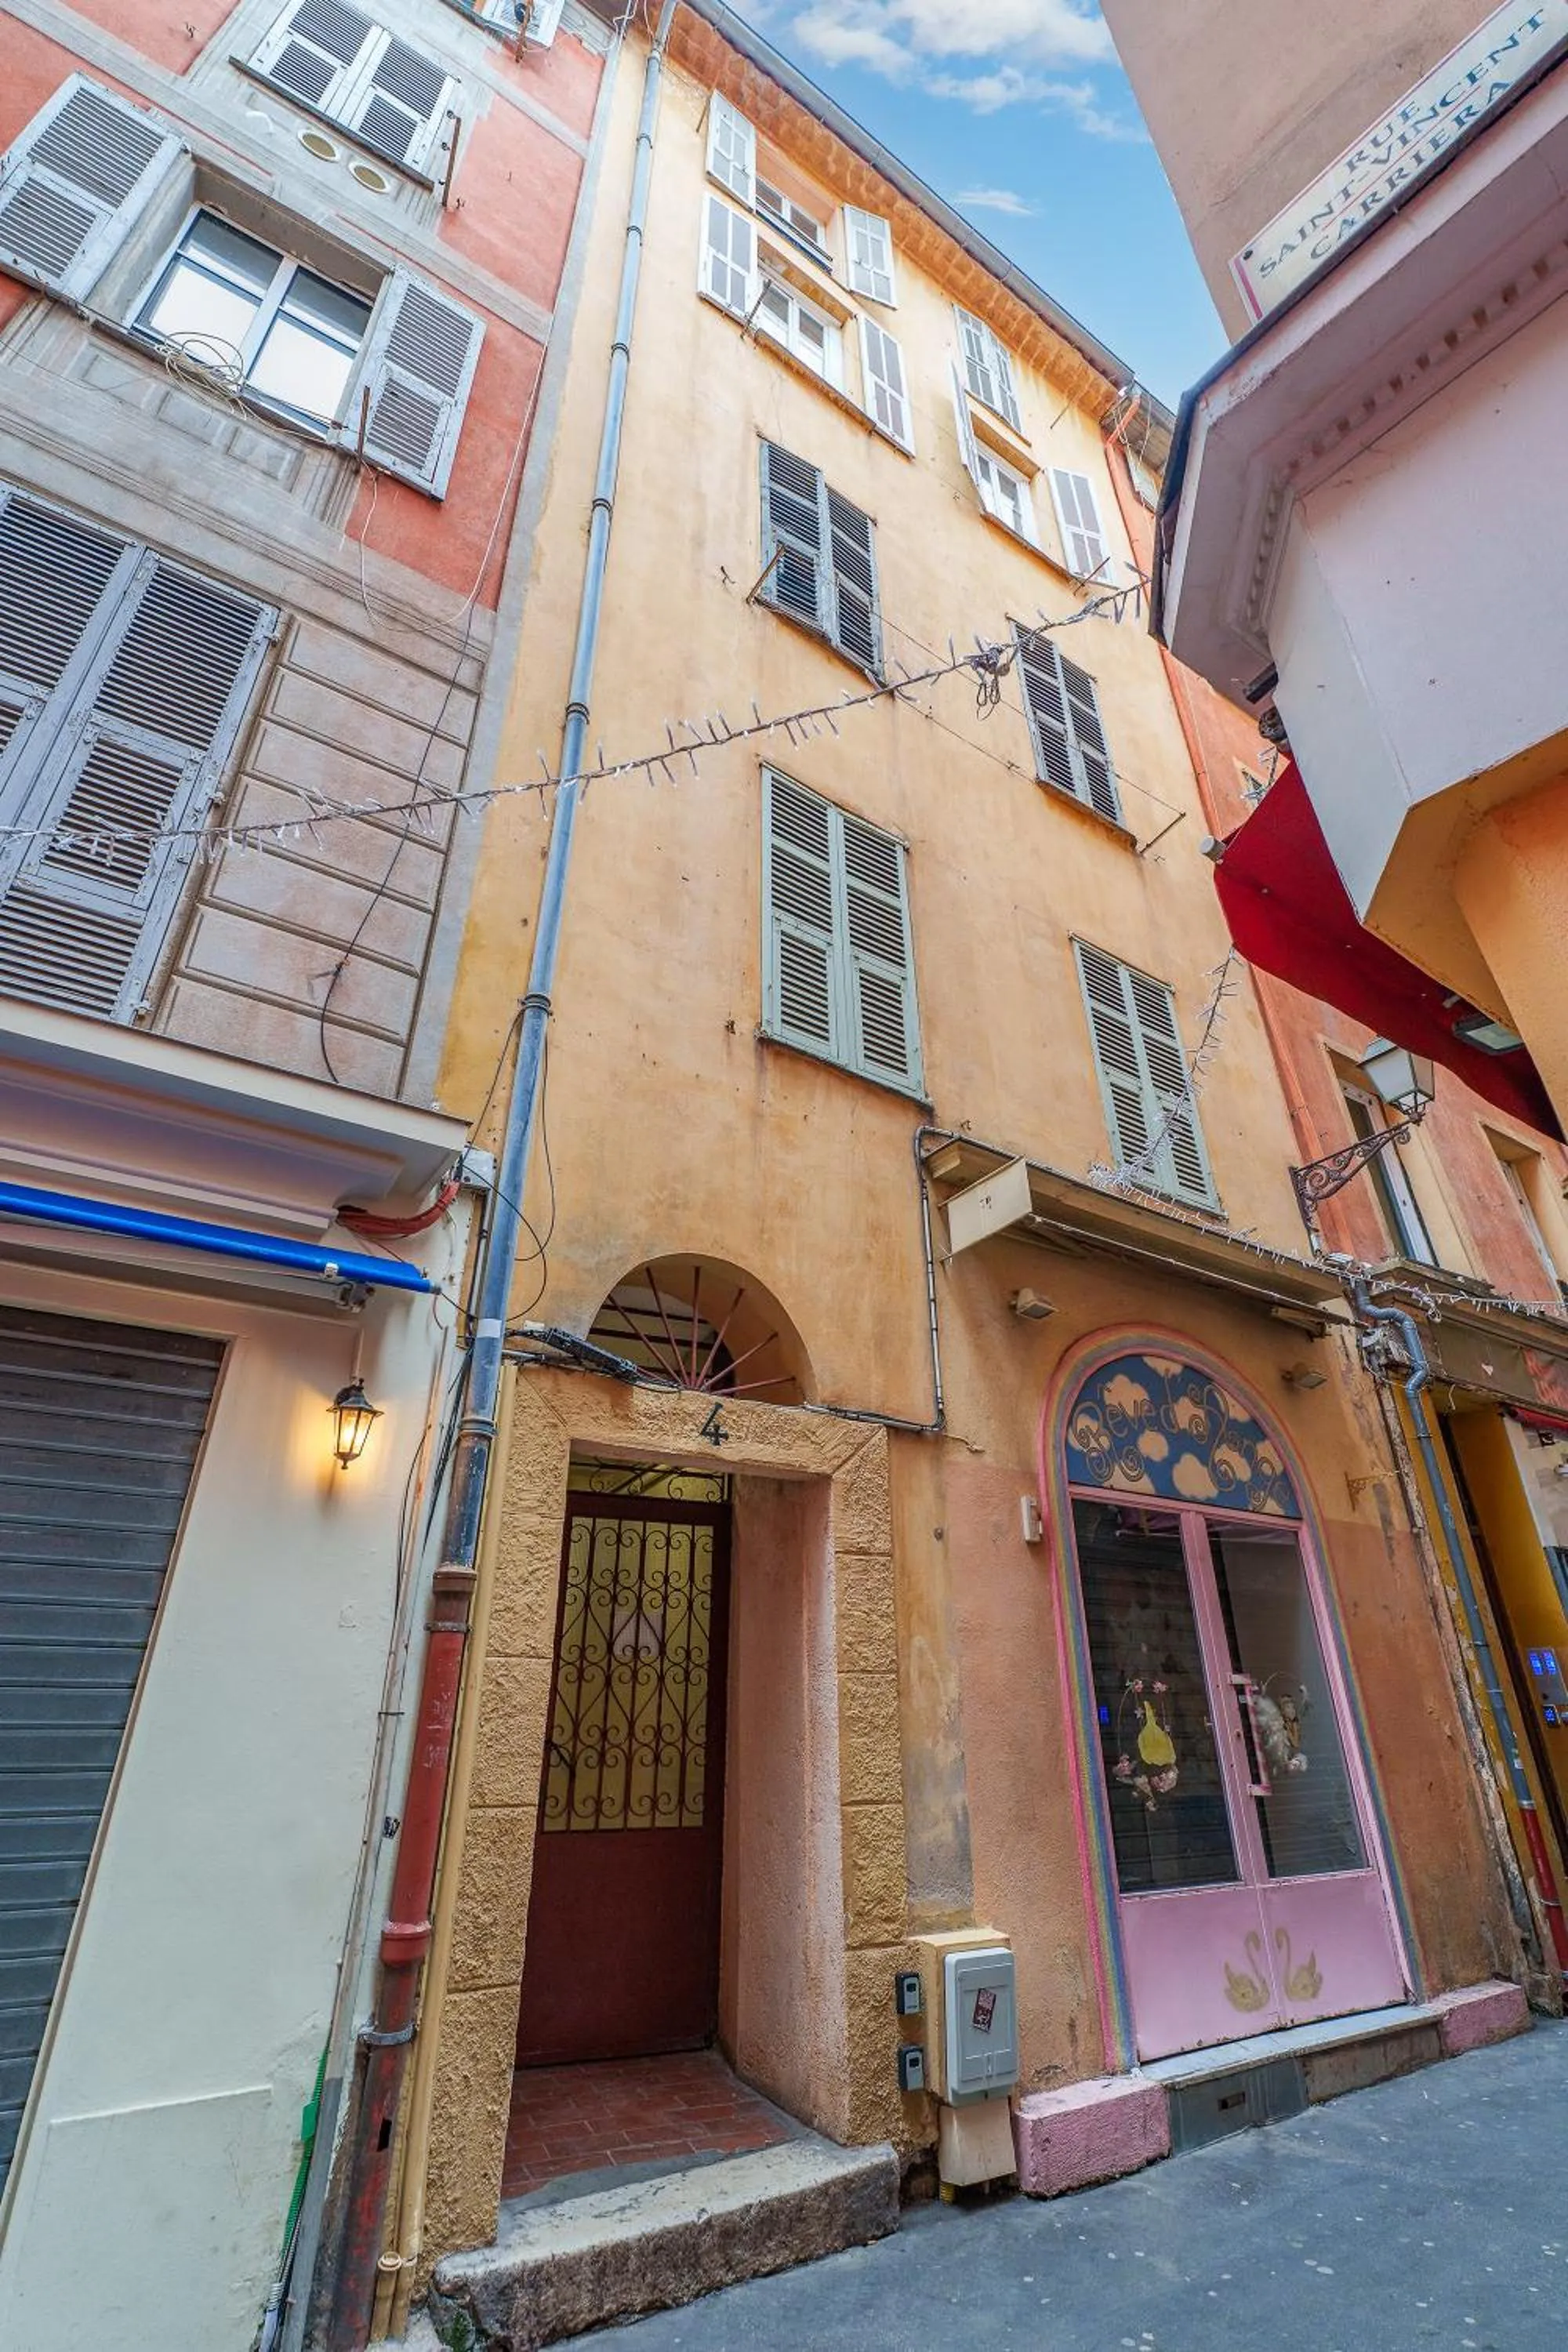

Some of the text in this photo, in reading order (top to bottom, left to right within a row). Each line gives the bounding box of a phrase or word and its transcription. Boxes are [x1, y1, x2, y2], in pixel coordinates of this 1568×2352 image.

[1258, 9, 1544, 279] SAINT-VINCENT
[1309, 81, 1511, 260] CARRIERA
[1346, 100, 1421, 174] RUE
[700, 1402, 729, 1446] 4
